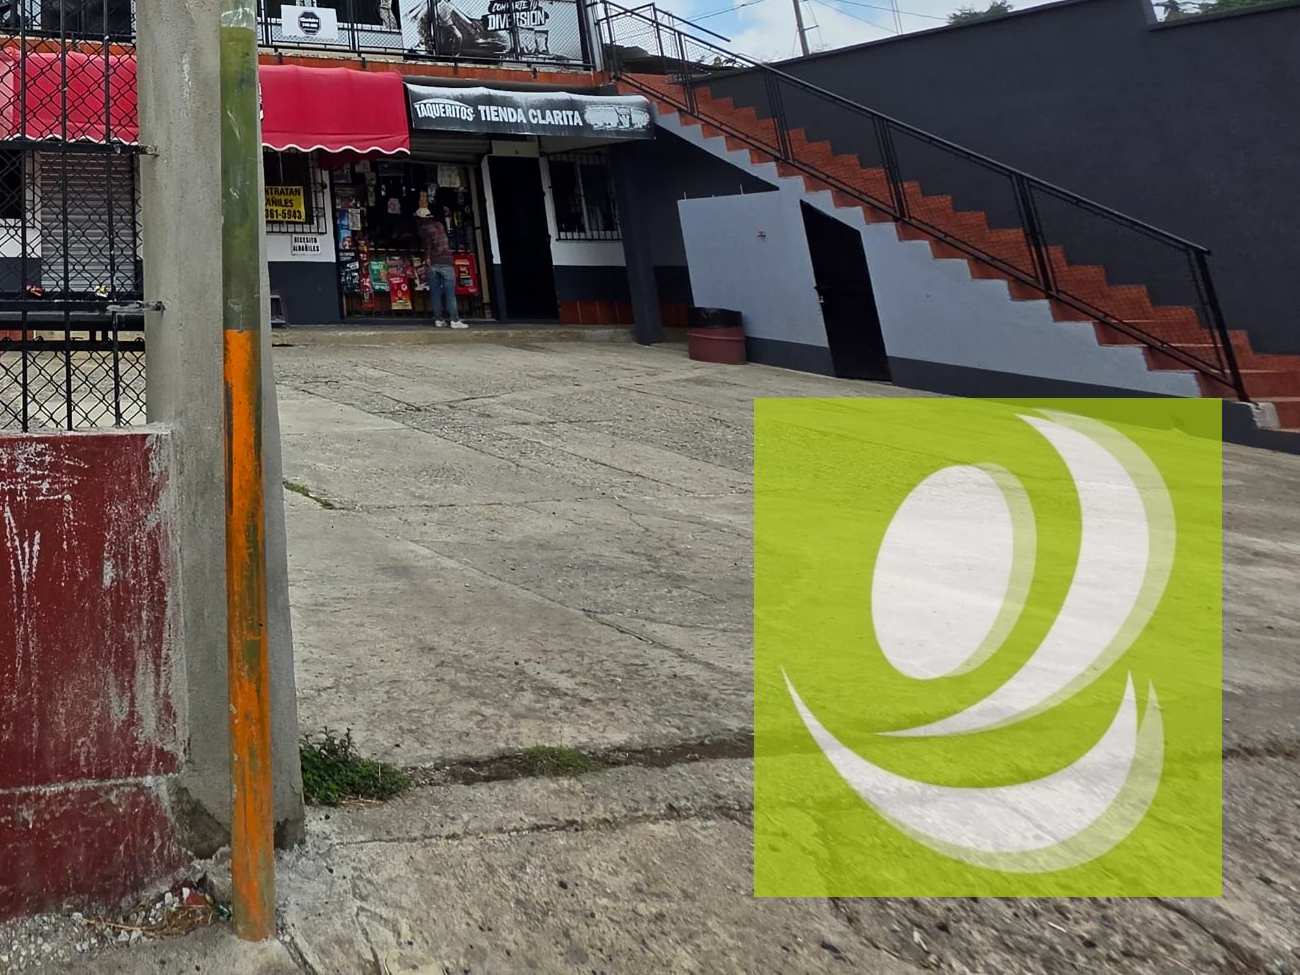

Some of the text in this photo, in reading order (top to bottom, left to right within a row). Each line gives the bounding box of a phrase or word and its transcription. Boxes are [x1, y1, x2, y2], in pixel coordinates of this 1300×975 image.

[414, 102, 584, 127] TAQUERITOS TIENDA CLARITA
